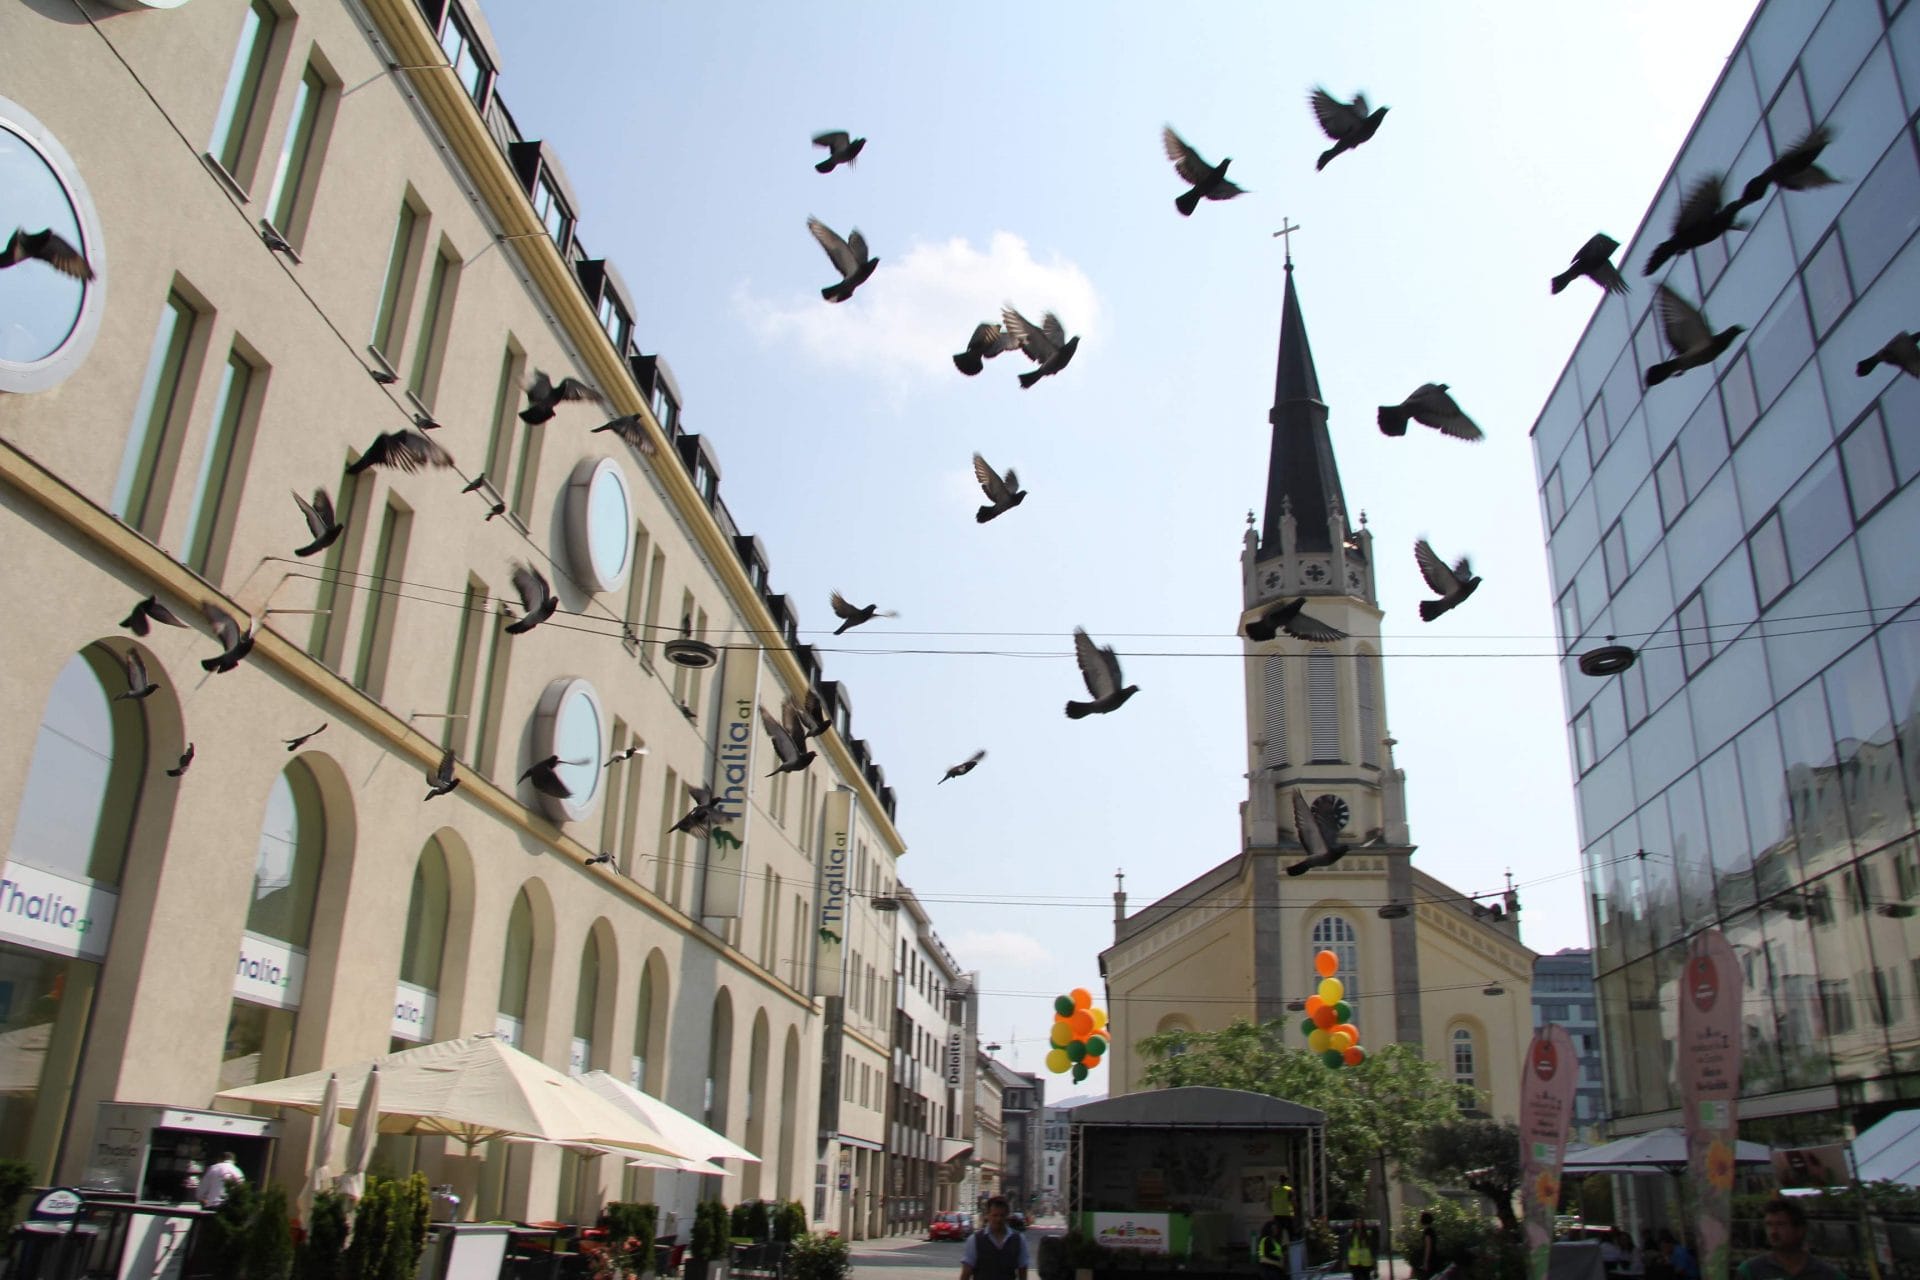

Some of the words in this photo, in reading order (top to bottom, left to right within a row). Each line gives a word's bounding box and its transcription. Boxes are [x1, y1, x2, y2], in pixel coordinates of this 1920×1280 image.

[822, 849, 845, 926] Thalia
[237, 950, 281, 985] halia
[949, 1034, 960, 1084] Deloitte
